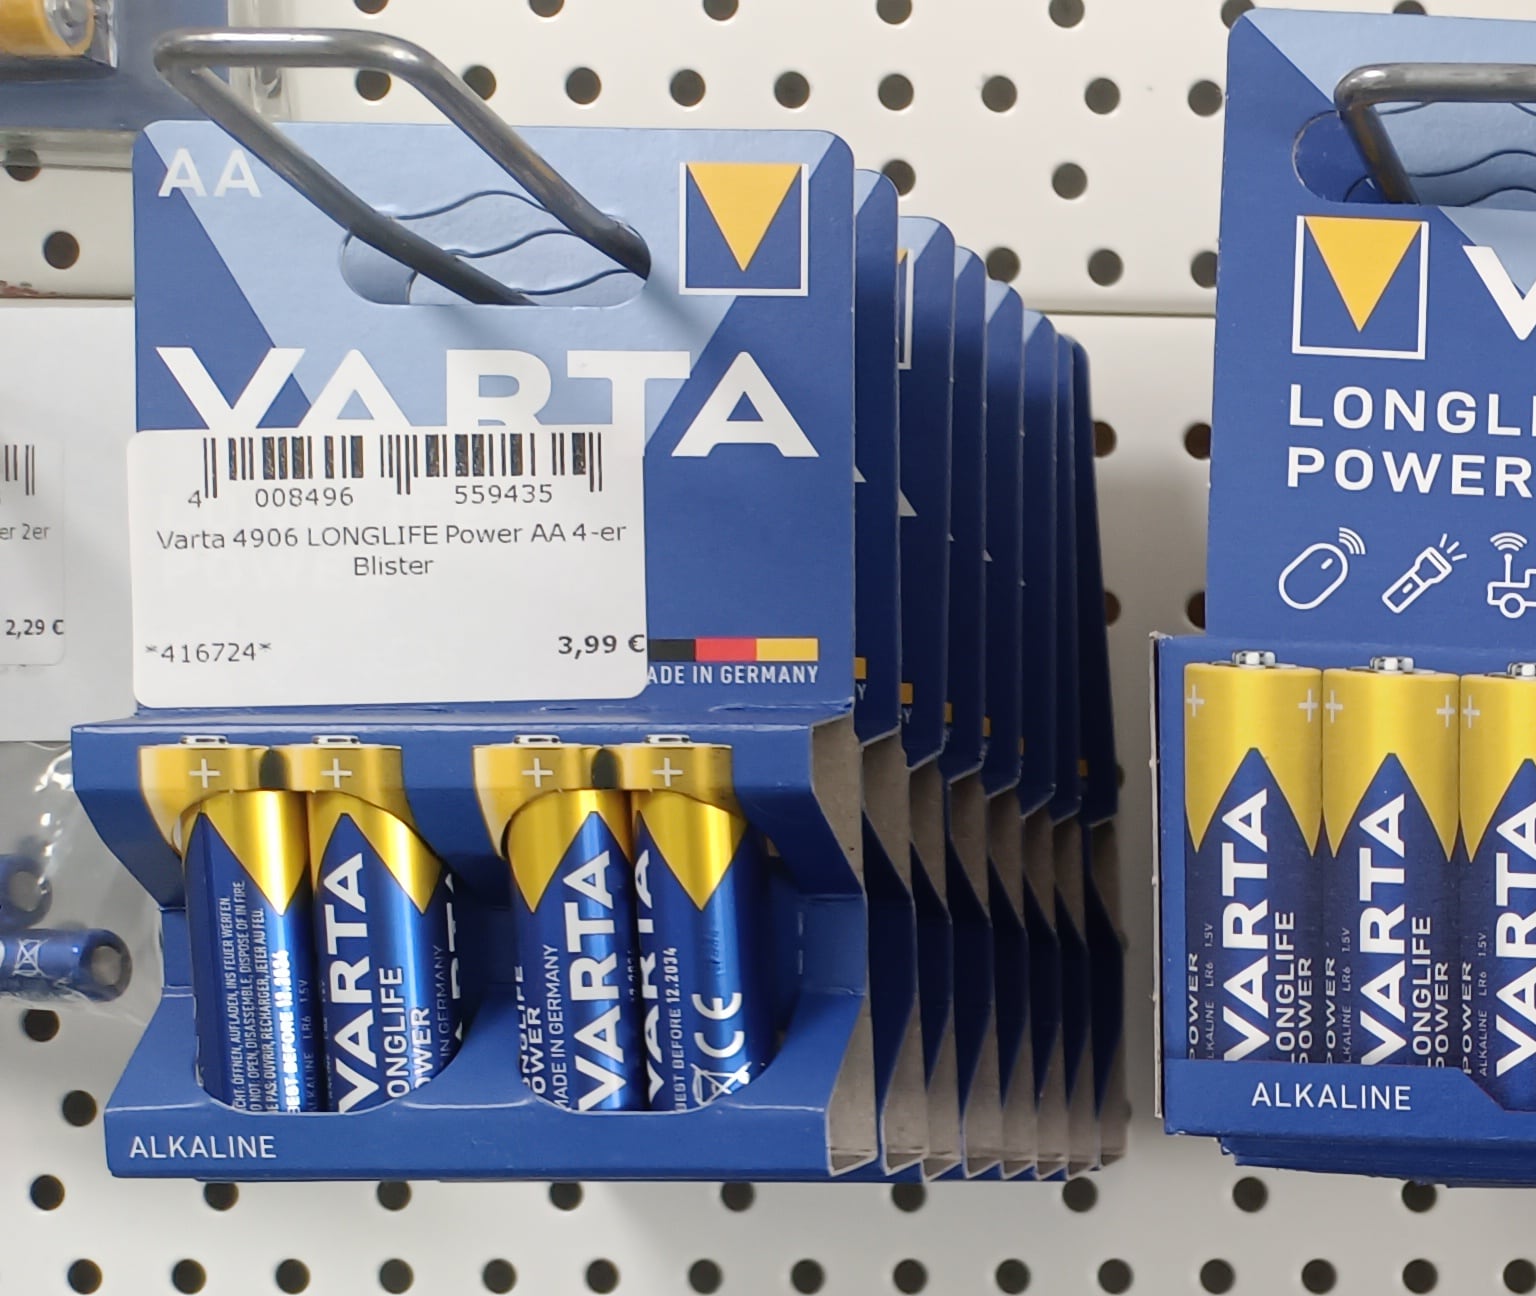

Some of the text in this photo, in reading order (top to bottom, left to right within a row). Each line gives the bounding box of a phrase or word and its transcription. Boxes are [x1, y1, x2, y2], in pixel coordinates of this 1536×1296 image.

[158, 148, 262, 198] AA
[156, 347, 820, 457] VARTA
[1288, 446, 1534, 498] POWER
[254, 483, 554, 509] 008496 559435
[21, 522, 50, 541] 2er
[156, 522, 627, 551] Varta 4906 LONGLIFE Power AA 4-er
[353, 554, 434, 577] Blister
[5, 618, 65, 640] 2,29 €
[557, 634, 646, 660] 3,99 €
[692, 664, 820, 686] IN GERMANY
[327, 852, 388, 1113] VARTA
[543, 944, 563, 1034] GERMANY
[1251, 1082, 1412, 1111] ALKALINE
[129, 1136, 276, 1161] ALKALINE
